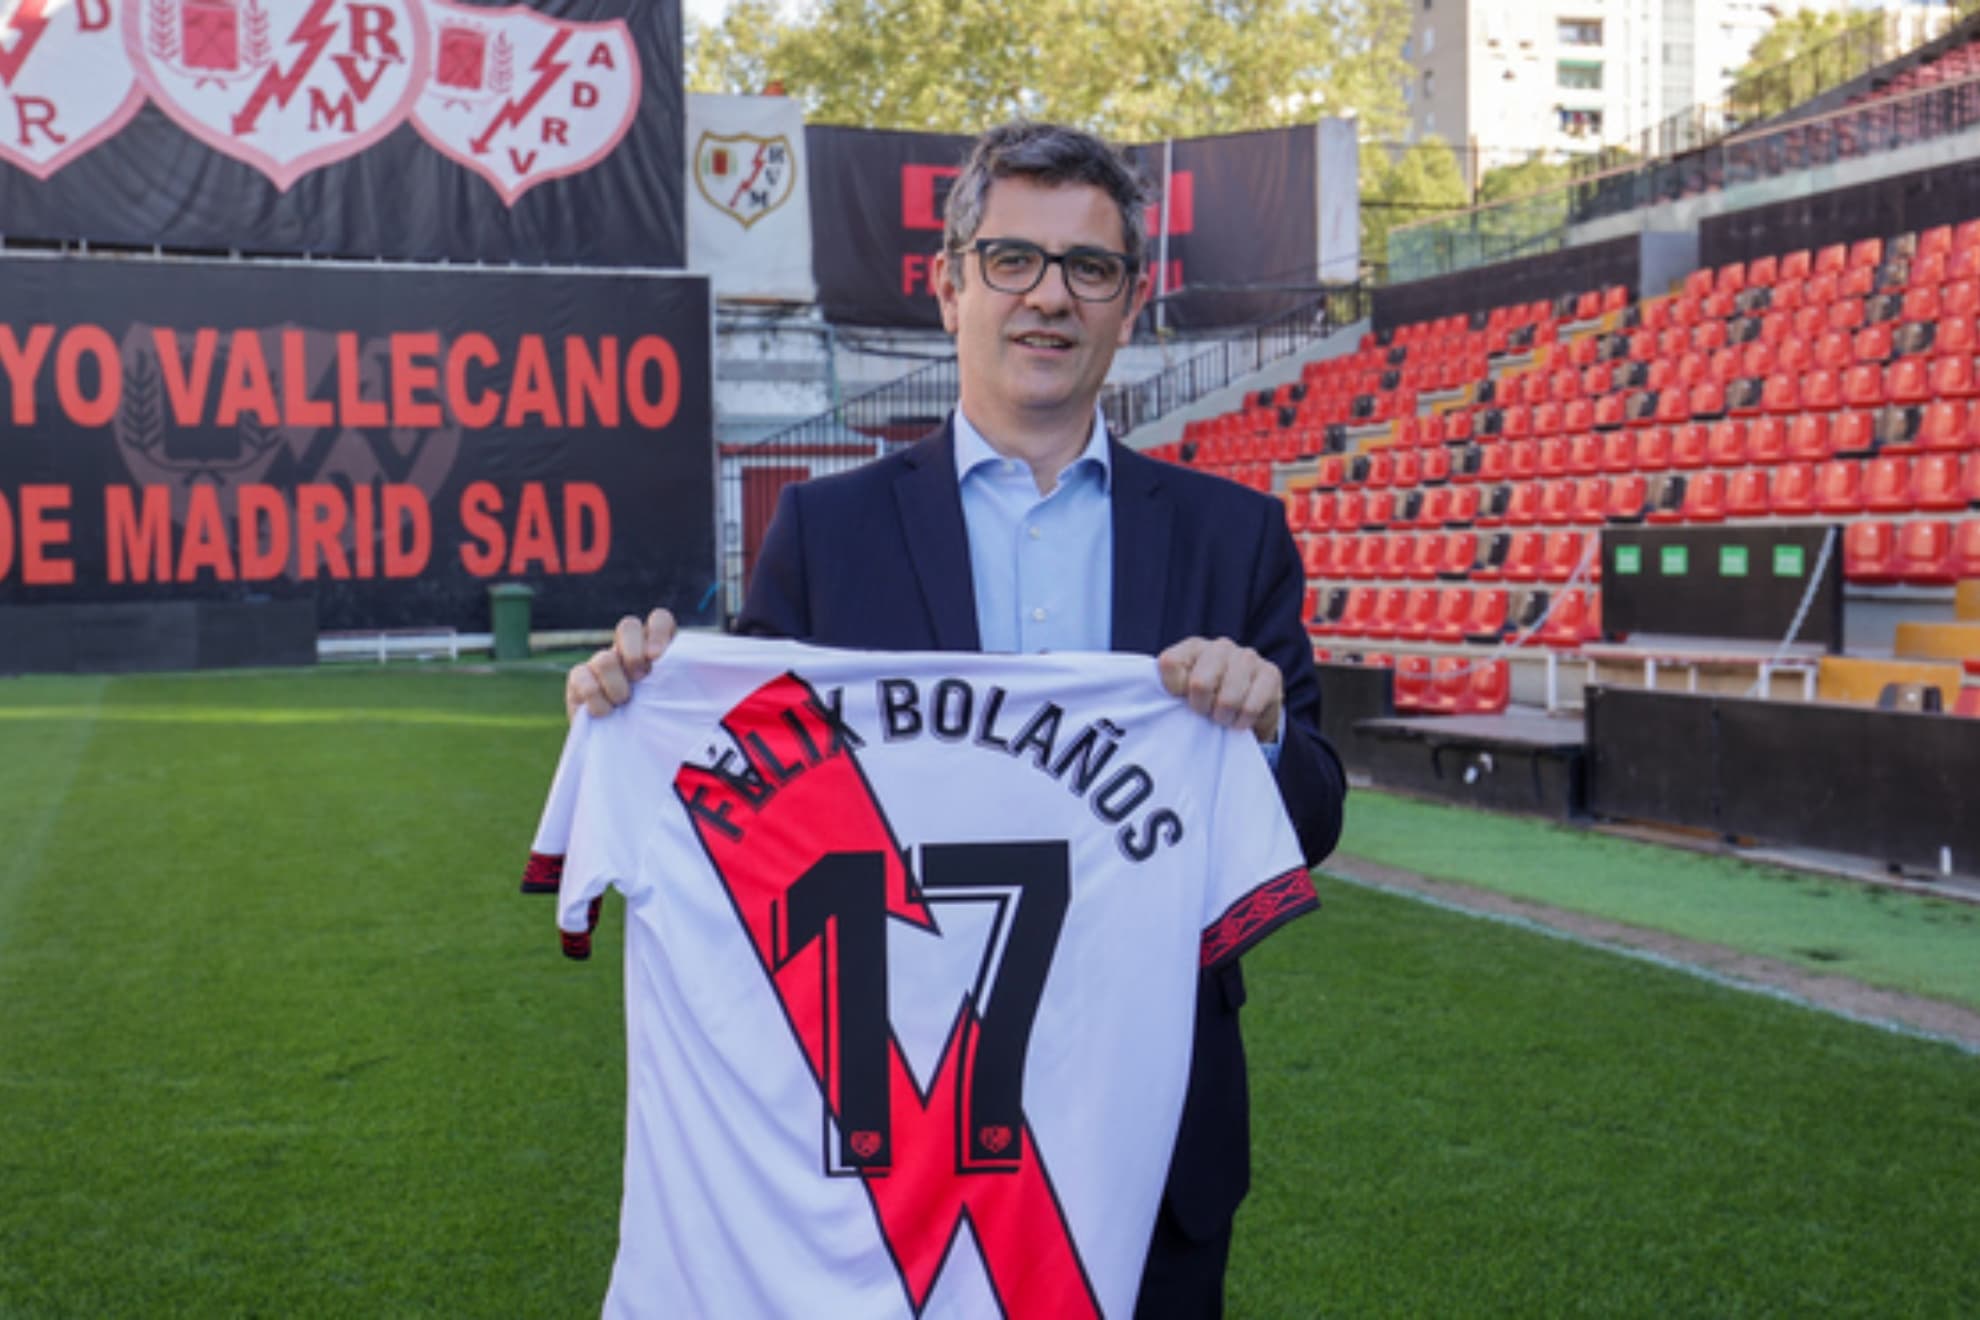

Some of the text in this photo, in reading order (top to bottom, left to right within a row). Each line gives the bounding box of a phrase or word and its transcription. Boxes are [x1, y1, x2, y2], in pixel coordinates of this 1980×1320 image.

[345, 3, 405, 64] R
[587, 41, 615, 71] A
[329, 54, 392, 104] V
[571, 80, 600, 110] D
[12, 92, 66, 145] R
[307, 86, 358, 133] M
[541, 116, 569, 146] R
[508, 148, 537, 176] V
[0, 322, 682, 431] YO VALLECANO
[104, 483, 432, 584] MADRID
[459, 480, 612, 578] SAD
[689, 678, 1183, 862] FÉLIX BOLAÑOS
[771, 839, 1072, 1178] 17
